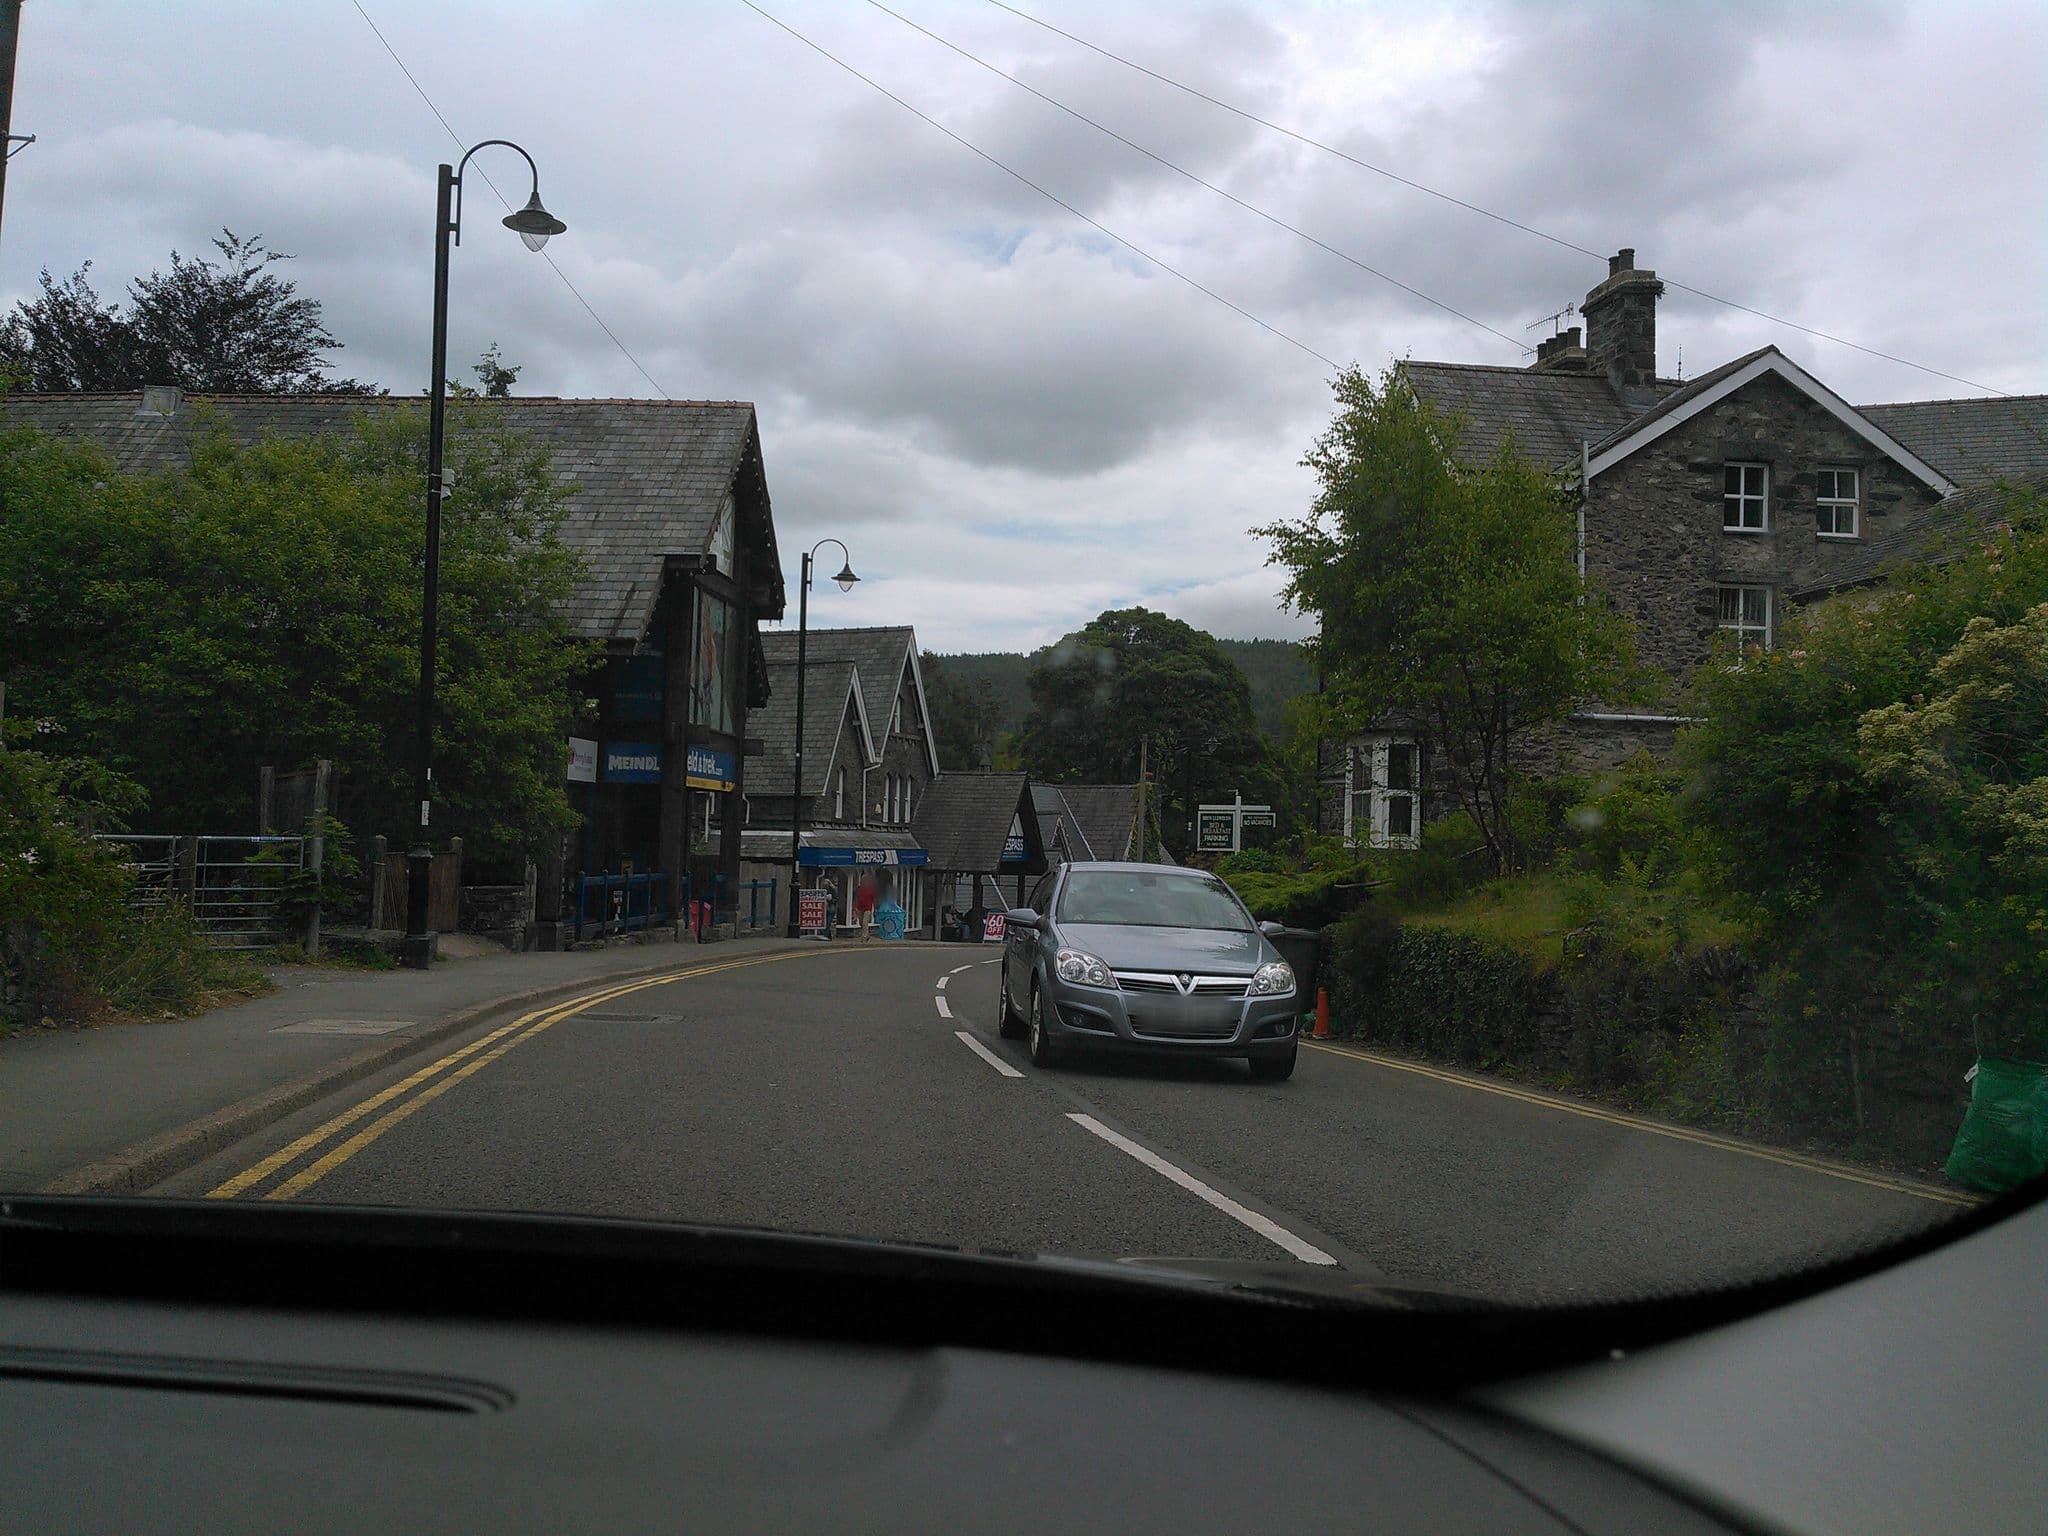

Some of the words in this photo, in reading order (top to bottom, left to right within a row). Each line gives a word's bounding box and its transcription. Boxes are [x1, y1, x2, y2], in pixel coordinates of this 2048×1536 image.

[608, 754, 660, 771] MEINDL
[687, 750, 698, 772] eld
[1005, 838, 1023, 852] ESPASS
[855, 851, 884, 864] TRESPASS
